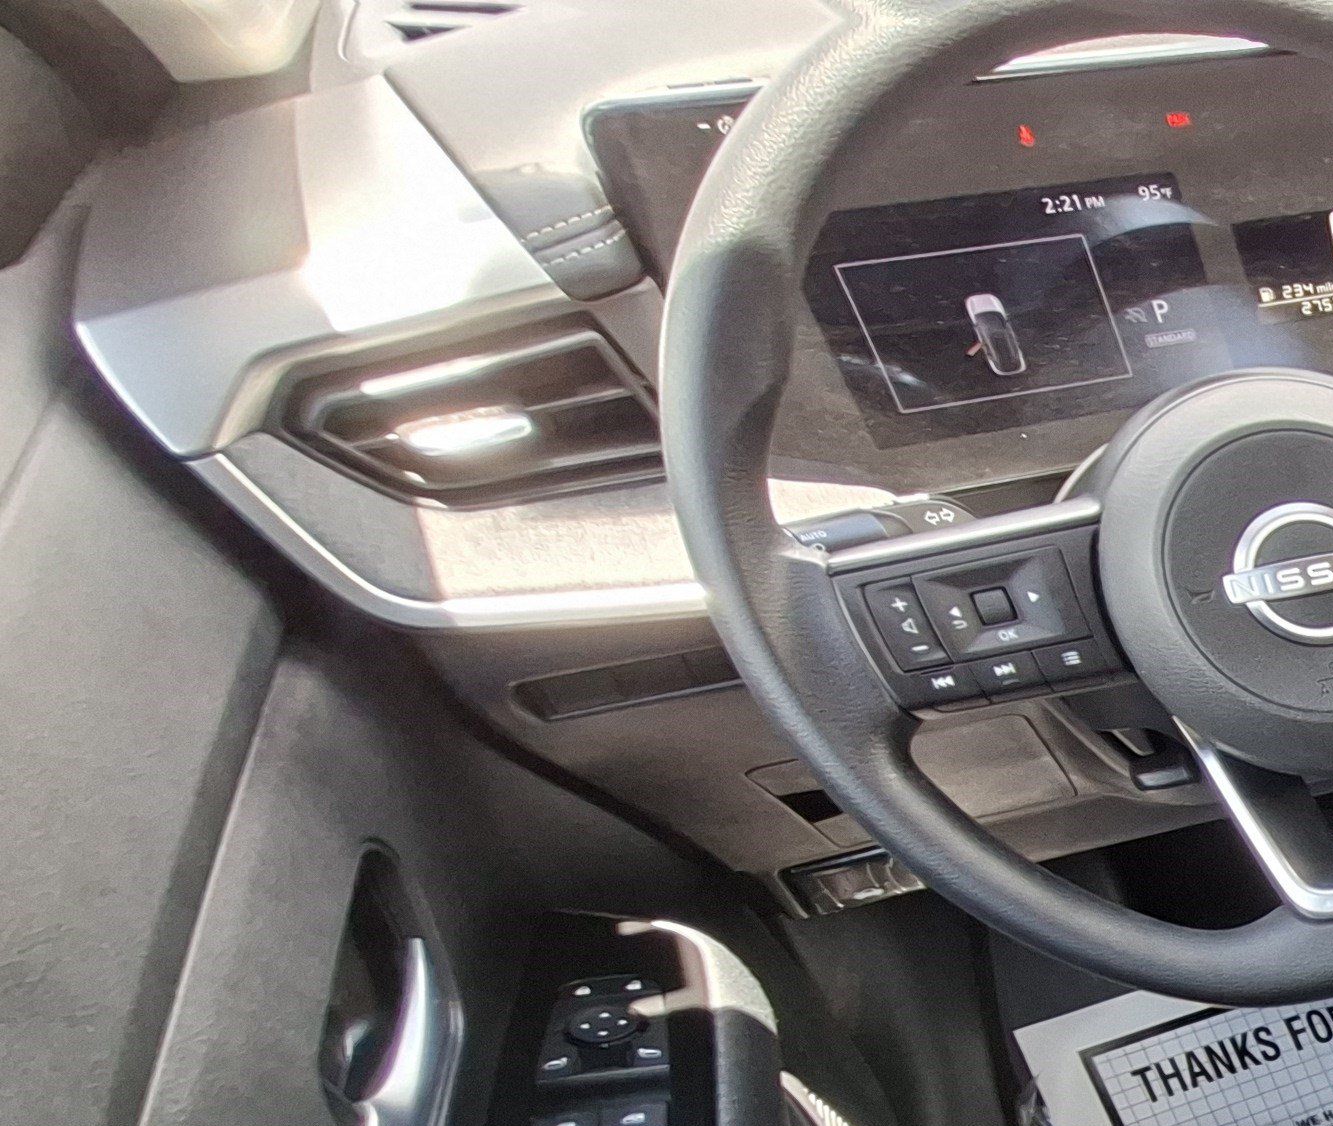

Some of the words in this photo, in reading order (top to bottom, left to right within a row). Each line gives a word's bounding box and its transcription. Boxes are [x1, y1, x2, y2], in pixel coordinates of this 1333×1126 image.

[1041, 194, 1082, 215] 2:21
[1084, 195, 1106, 209] PM
[1282, 283, 1314, 298] 234
[1152, 299, 1169, 323] P
[800, 530, 828, 541] AUTO
[997, 628, 1018, 641] OK
[1130, 1026, 1281, 1103] THANKS
